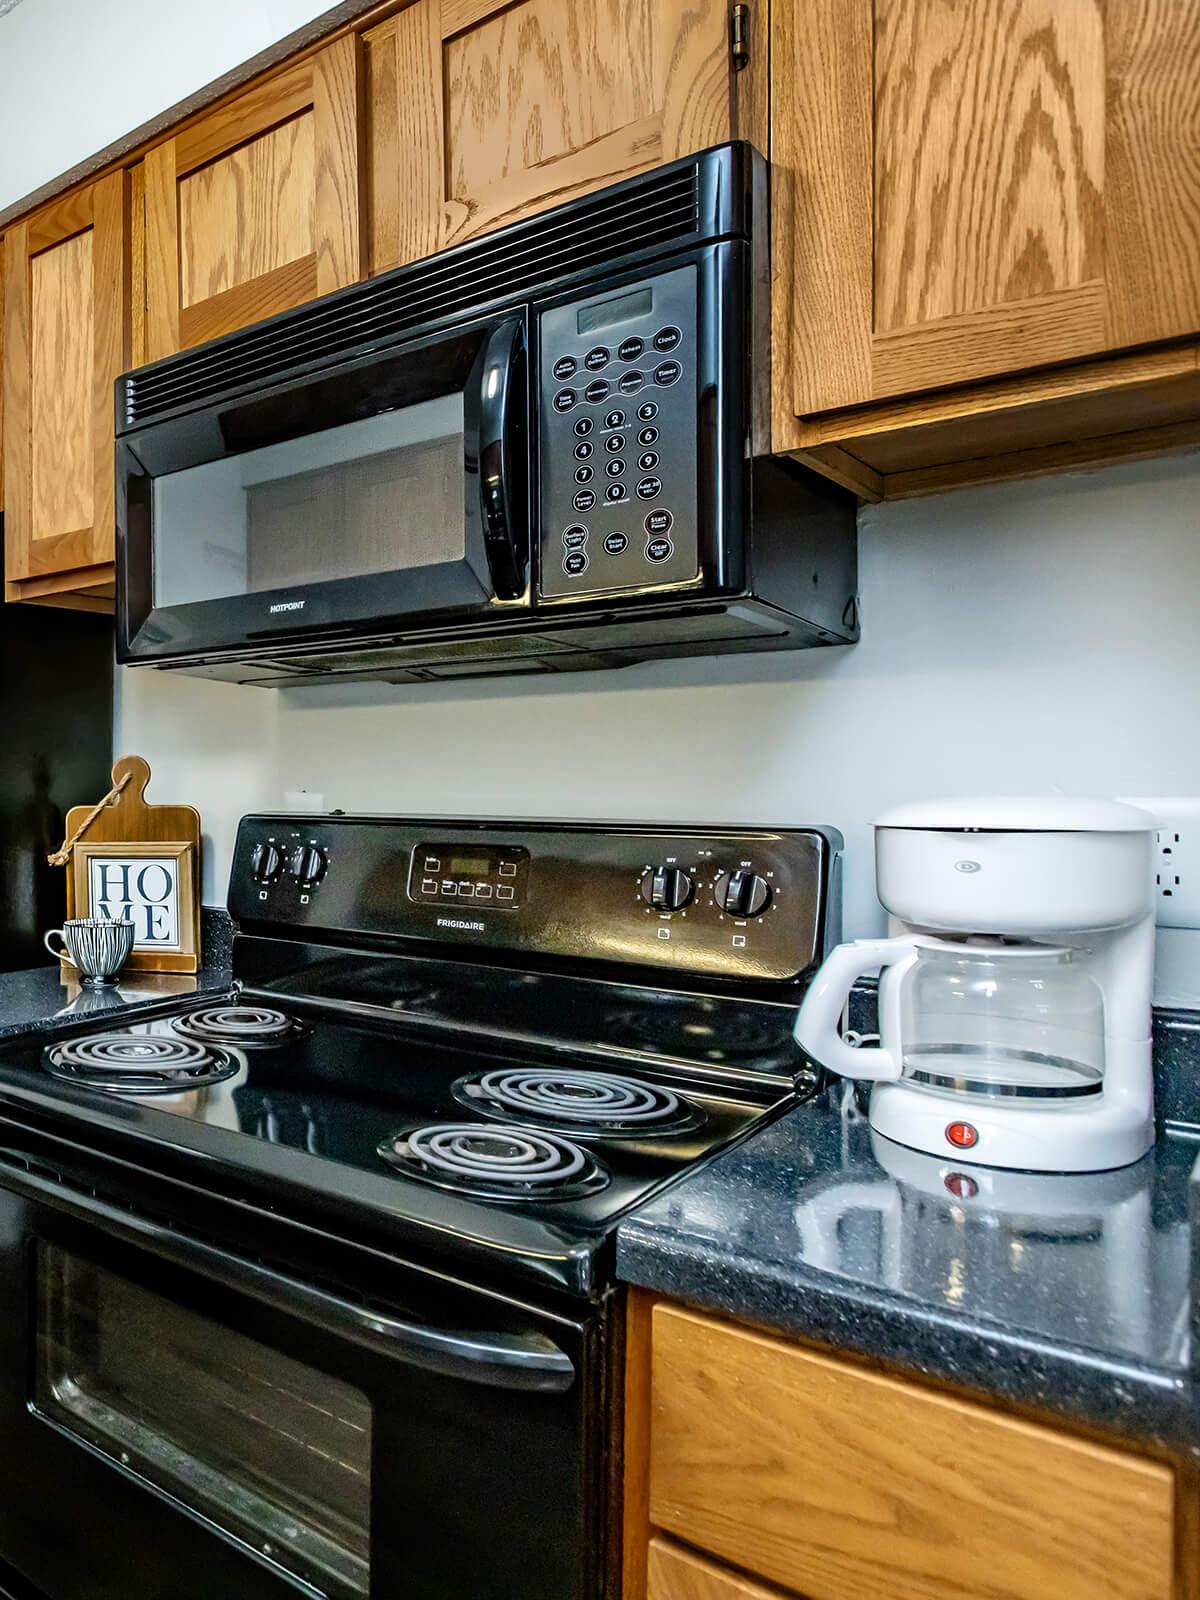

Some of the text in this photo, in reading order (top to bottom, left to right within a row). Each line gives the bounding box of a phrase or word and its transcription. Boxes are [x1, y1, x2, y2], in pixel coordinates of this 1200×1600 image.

[657, 334, 677, 345] Clock
[658, 368, 677, 377] Timer
[644, 407, 652, 416] 3
[611, 415, 619, 424] 2
[580, 423, 586, 431] 1
[644, 431, 652, 441] 6
[612, 438, 619, 448] 5
[580, 446, 587, 455] 4
[644, 456, 652, 466] 9
[612, 463, 619, 473] 8
[581, 470, 588, 479] 7
[612, 487, 619, 497] 0
[270, 601, 305, 613] HOTPOINT
[97, 864, 173, 903] HO
[436, 918, 485, 931] FRIGIDAIRE
